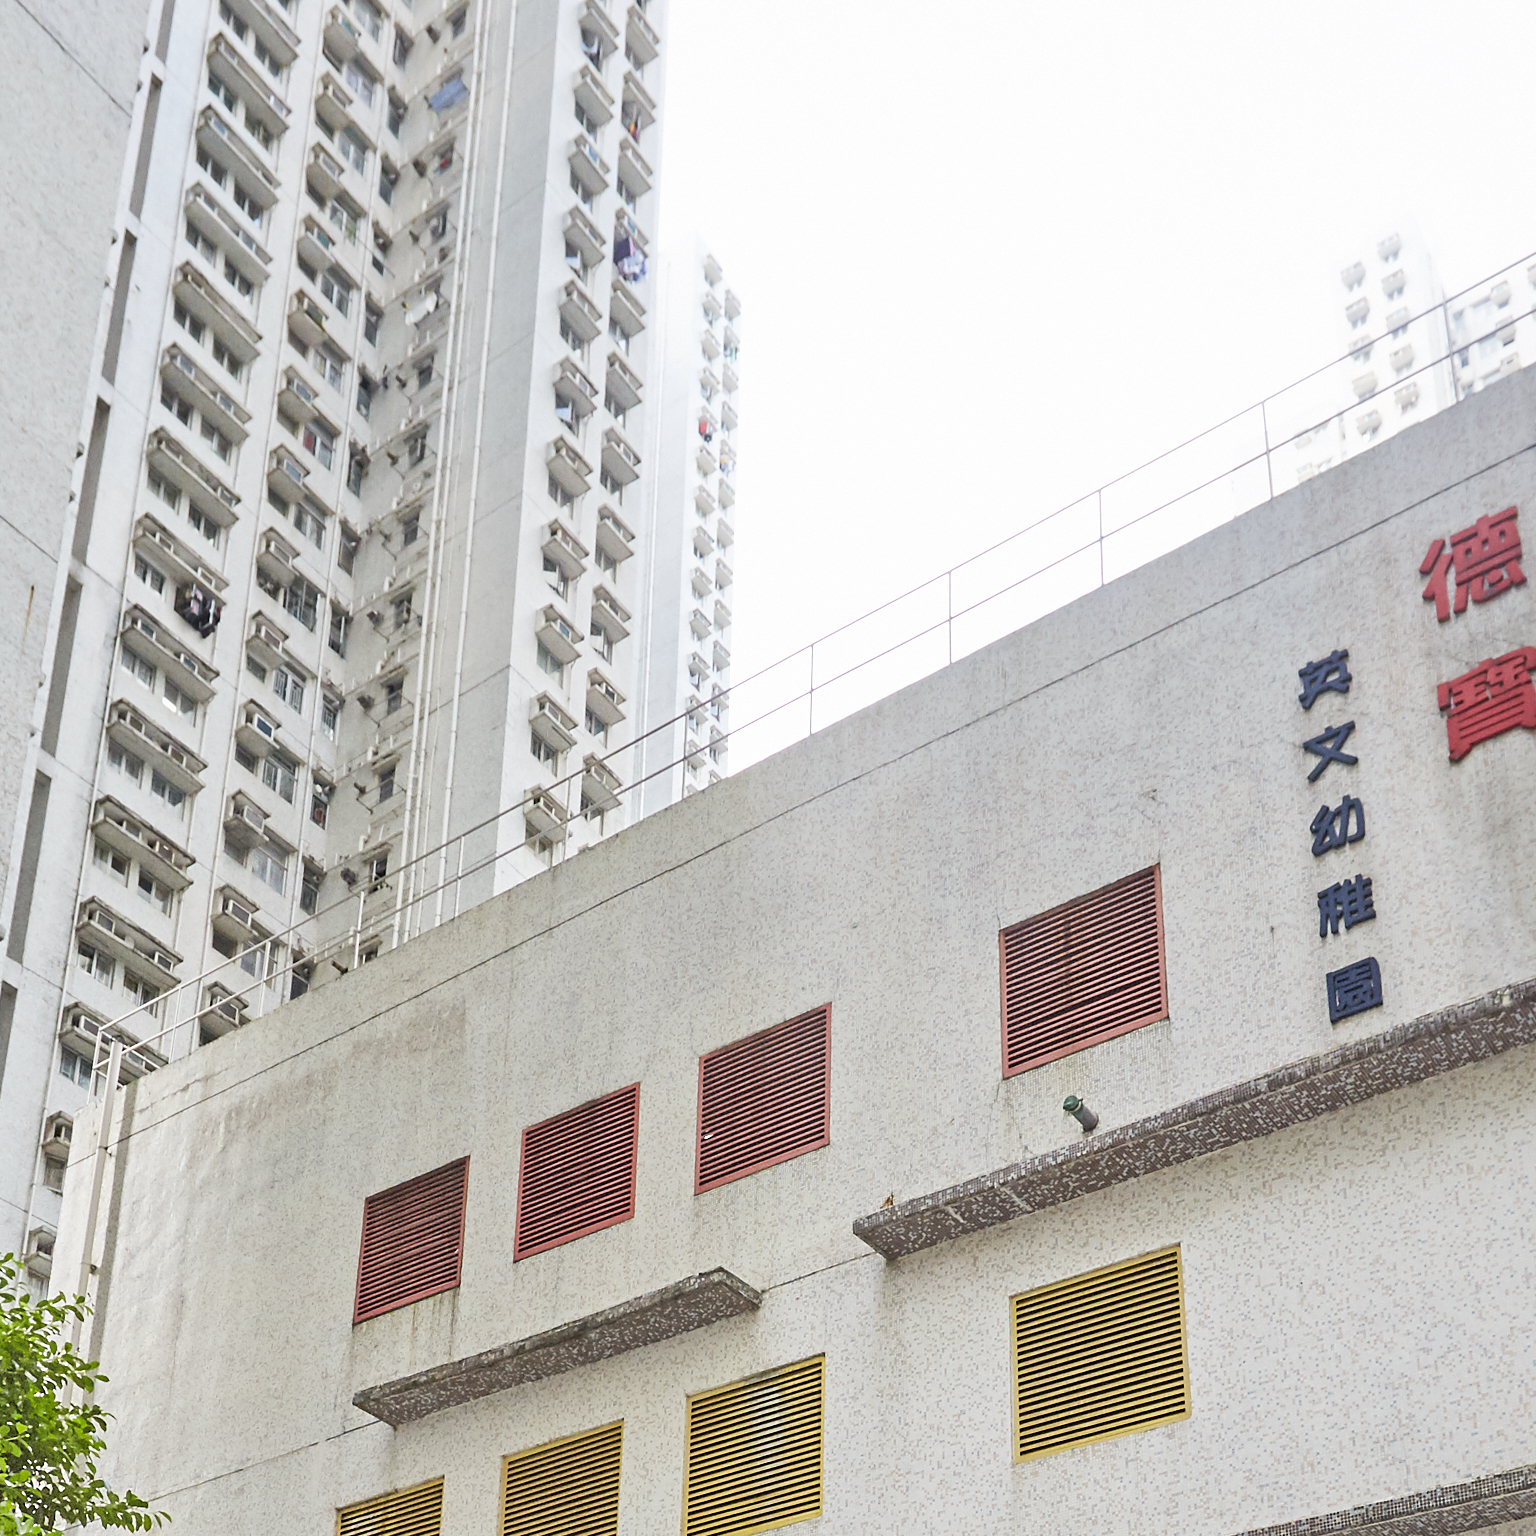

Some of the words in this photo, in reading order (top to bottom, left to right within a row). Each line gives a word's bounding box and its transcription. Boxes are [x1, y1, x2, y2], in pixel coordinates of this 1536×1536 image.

[1298, 649, 1384, 1024] 英文幼稚園
